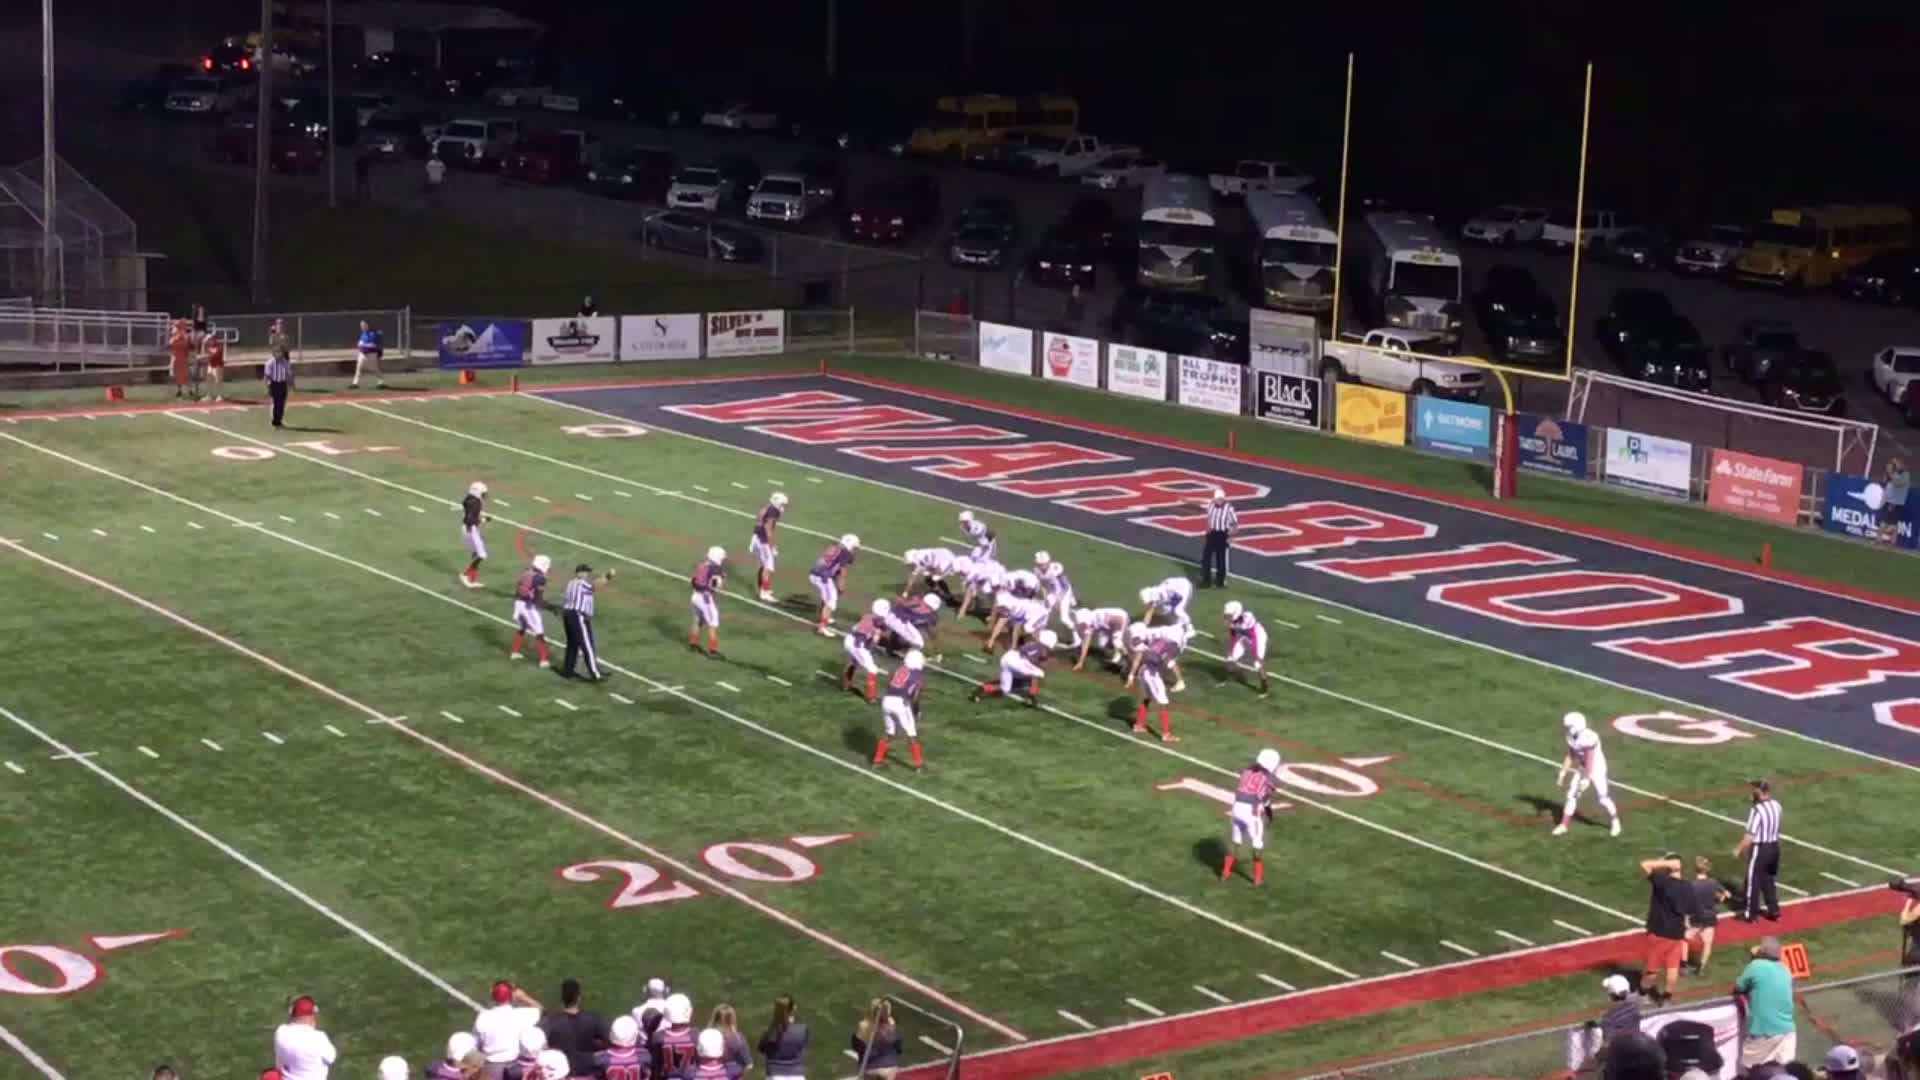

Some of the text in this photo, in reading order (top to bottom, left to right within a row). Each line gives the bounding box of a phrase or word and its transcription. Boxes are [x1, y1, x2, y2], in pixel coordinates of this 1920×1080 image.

[1184, 369, 1238, 386] TROPHY
[660, 390, 1920, 734] WARRIOR
[557, 840, 820, 908] 20
